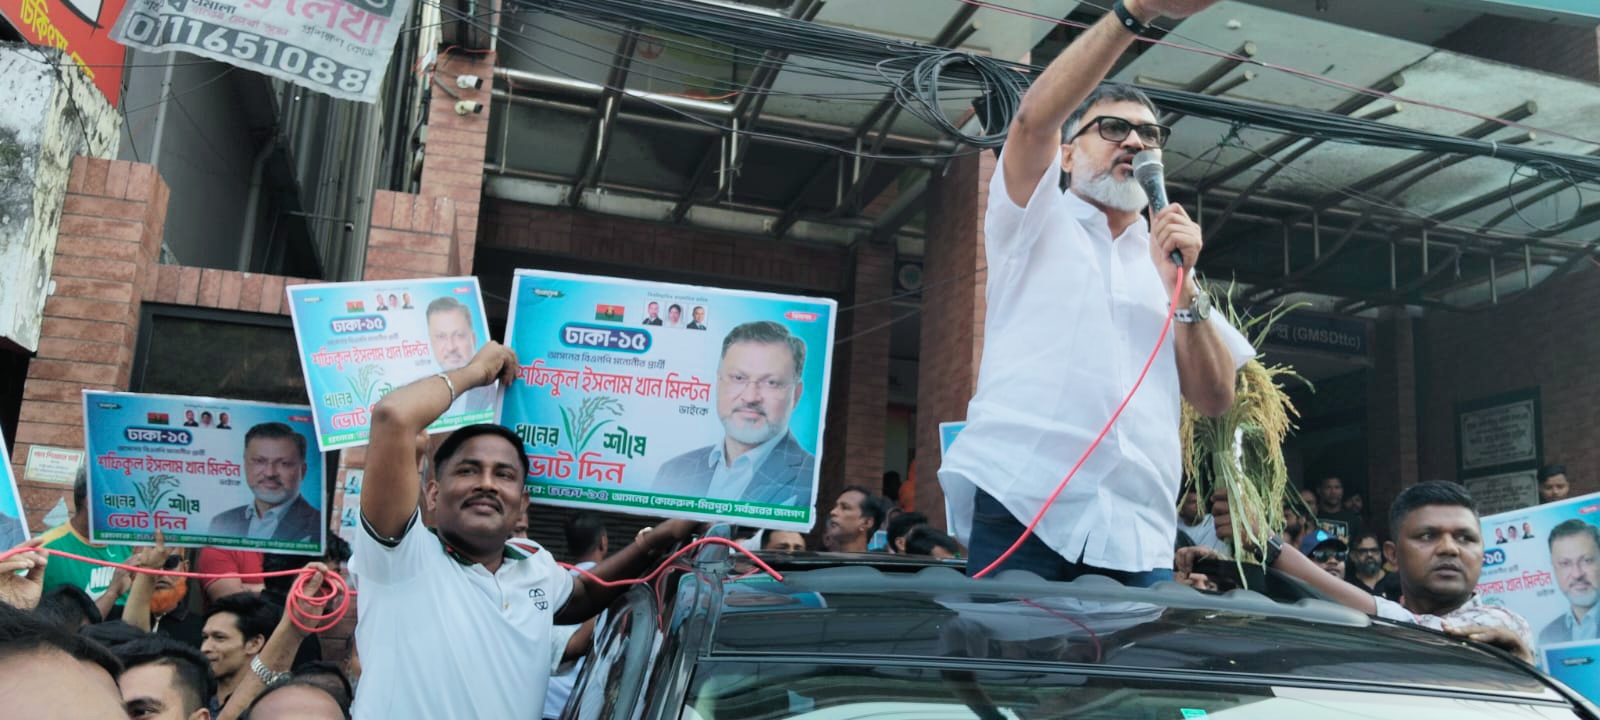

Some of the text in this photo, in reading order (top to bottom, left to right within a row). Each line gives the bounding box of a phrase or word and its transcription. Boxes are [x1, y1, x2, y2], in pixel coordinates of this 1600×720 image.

[332, 318, 384, 333] ঢাকা-১৫
[564, 326, 647, 350] ঢাকা-১৫
[516, 359, 711, 402] শফিকুল ইসলাম খান মিল্টন
[331, 407, 368, 430] ভোট
[127, 428, 189, 444] ঢাকা-১৫
[515, 424, 647, 459] ধানের শীষে
[97, 451, 144, 476] শফিকুল
[146, 455, 183, 473] ইসলাম
[578, 451, 626, 484] দিন
[104, 493, 200, 515] ধানের শীষে
[108, 509, 188, 531] ভোট দিন
